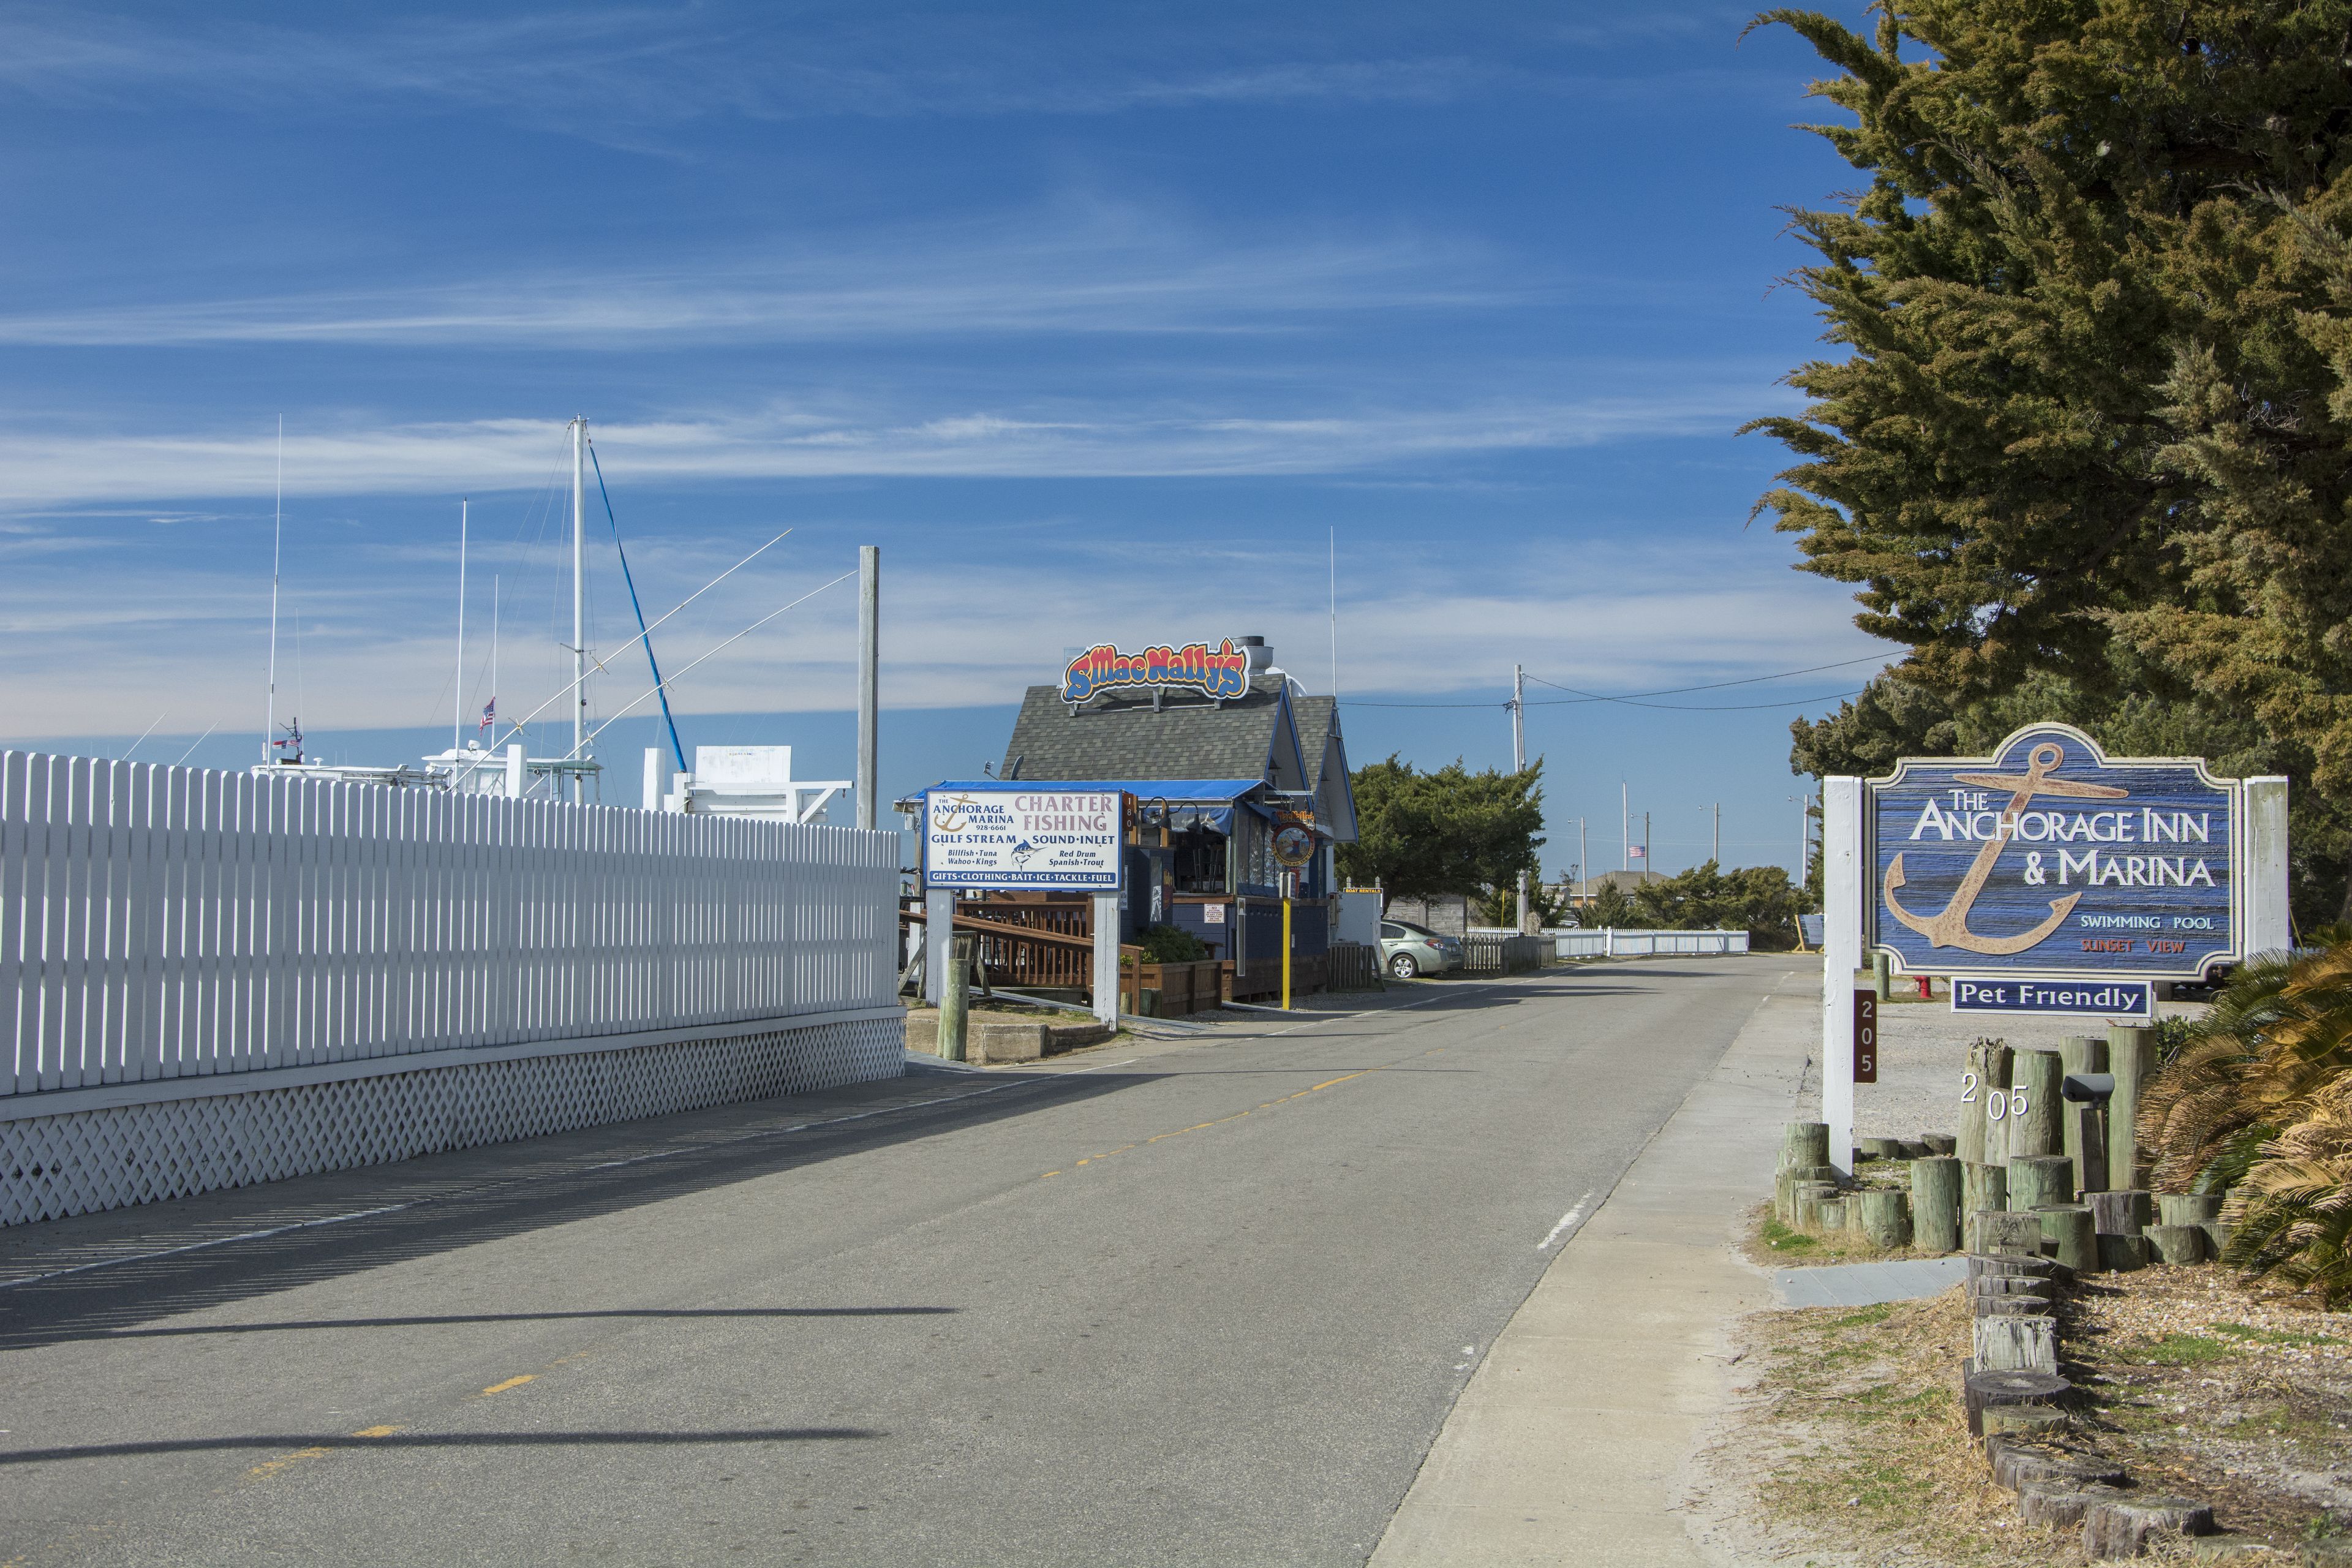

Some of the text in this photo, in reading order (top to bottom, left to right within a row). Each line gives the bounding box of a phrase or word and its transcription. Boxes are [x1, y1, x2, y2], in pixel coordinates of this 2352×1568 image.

[1015, 796, 1113, 812] CHARTER
[1948, 790, 1989, 811] THE
[933, 805, 1005, 813] ANCHORAGE
[968, 815, 1014, 824] MARINA
[1023, 815, 1107, 831] FISHING
[1909, 797, 2209, 843] ANCHORAGE INN
[931, 834, 1017, 843] GULF STREAM
[976, 858, 997, 867] Kings
[2024, 849, 2217, 887] & MARINA
[2081, 916, 2214, 930] SWIMMING POOL
[2081, 940, 2185, 952] SUNSET VIEW
[1961, 984, 2139, 1010] Pet Friendly
[1861, 1001, 1872, 1072] 205
[1961, 1073, 2029, 1121] 205
